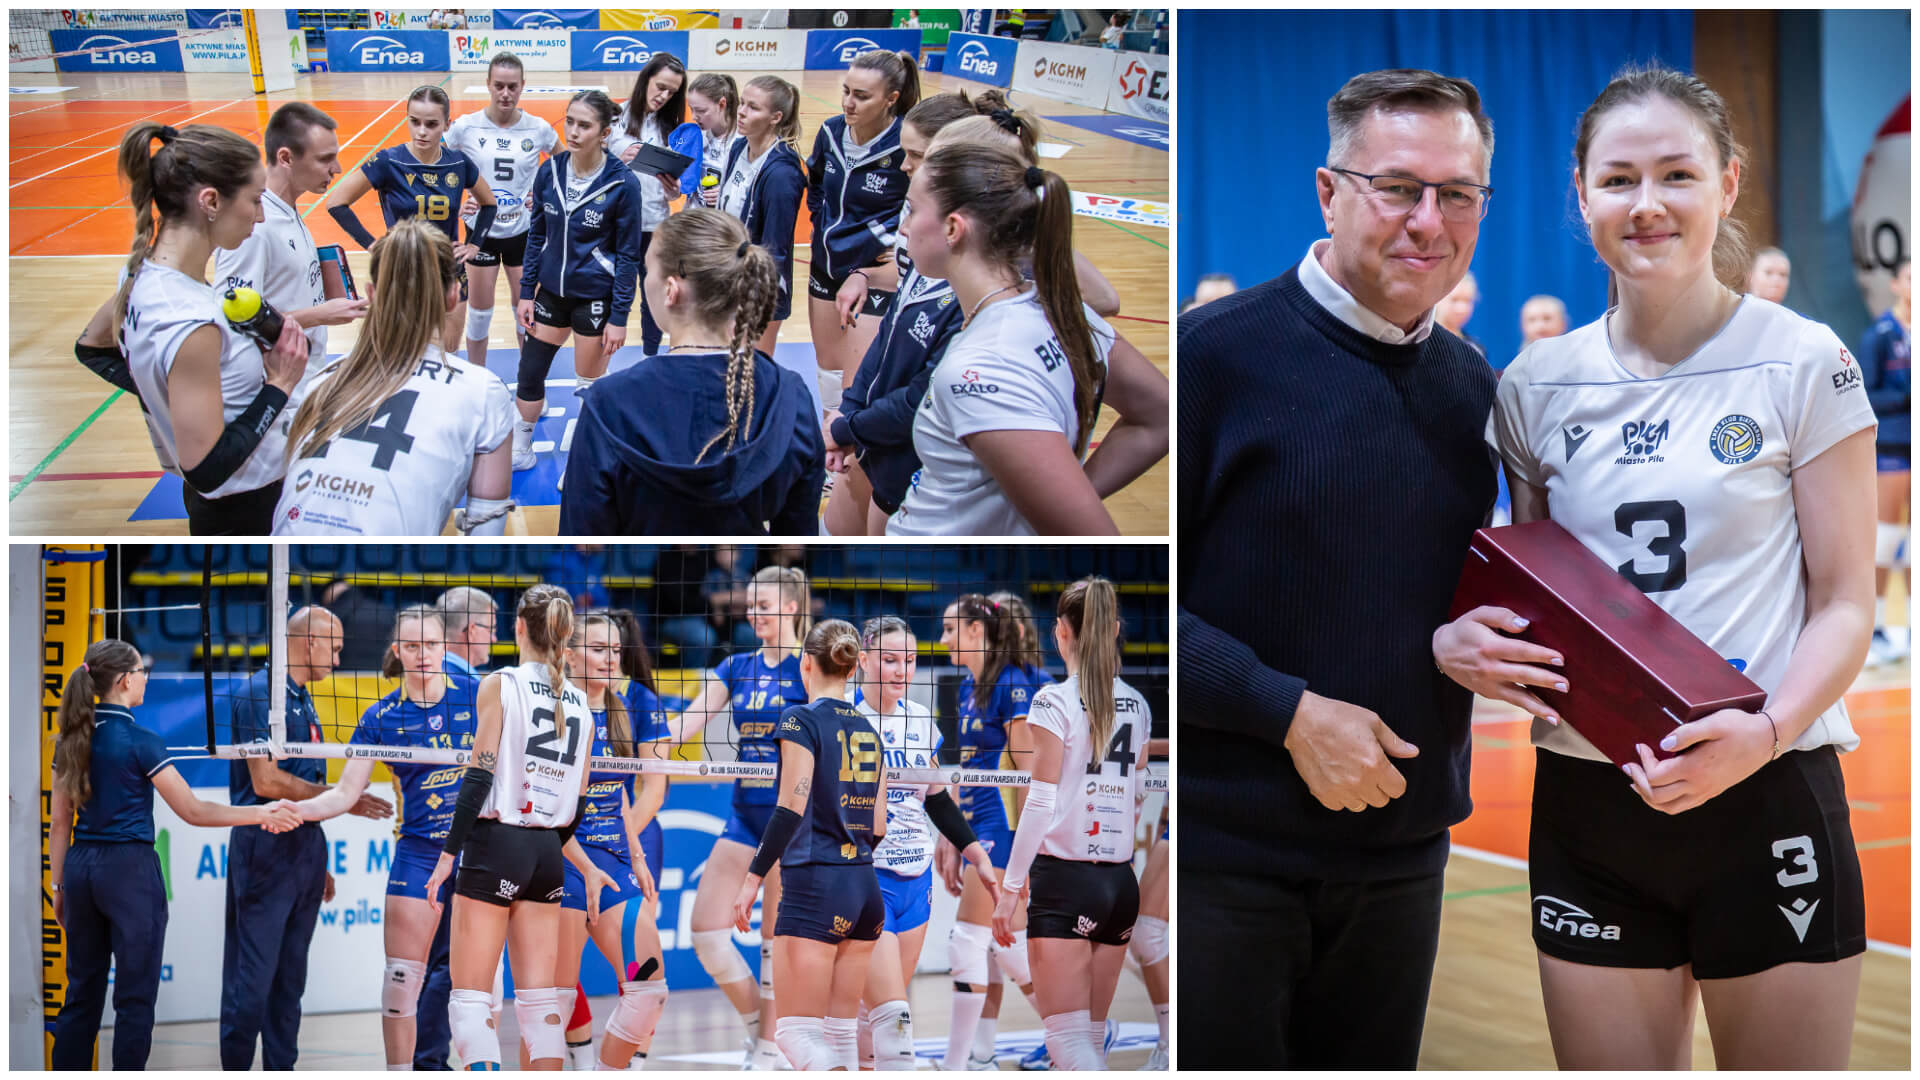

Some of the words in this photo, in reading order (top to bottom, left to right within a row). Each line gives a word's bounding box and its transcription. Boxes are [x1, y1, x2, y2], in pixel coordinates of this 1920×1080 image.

[650, 20, 670, 30] LOTTO
[735, 41, 777, 51] KGHM
[90, 47, 157, 64] Enea
[192, 52, 247, 60] WWW.PILA.P
[361, 48, 424, 64] Enea
[602, 47, 651, 64] Ene
[960, 53, 998, 76] Enea
[1049, 62, 1087, 81] KGHM
[494, 158, 515, 181] 5
[415, 194, 450, 221] 18
[495, 195, 523, 206] nea
[591, 301, 604, 314] 6
[1034, 336, 1066, 373] BA
[950, 384, 1000, 395] EXALO
[1614, 457, 1645, 465] Miasto
[315, 473, 375, 500] KGHM
[1614, 500, 1687, 593] 3
[44, 577, 66, 731] SPORT
[745, 691, 768, 710] 18
[525, 707, 580, 766] 21
[370, 750, 400, 758] SIATKARSKI
[837, 729, 882, 783] 18
[538, 764, 565, 778] KGHM
[963, 774, 979, 782] KLUB
[981, 775, 1016, 784] SIATKARSKI
[1017, 776, 1031, 784] PIŁA
[1098, 784, 1125, 795] KGHM
[1153, 780, 1167, 788] PIŁA
[1771, 835, 1819, 888] 3
[1540, 905, 1621, 941] Enea
